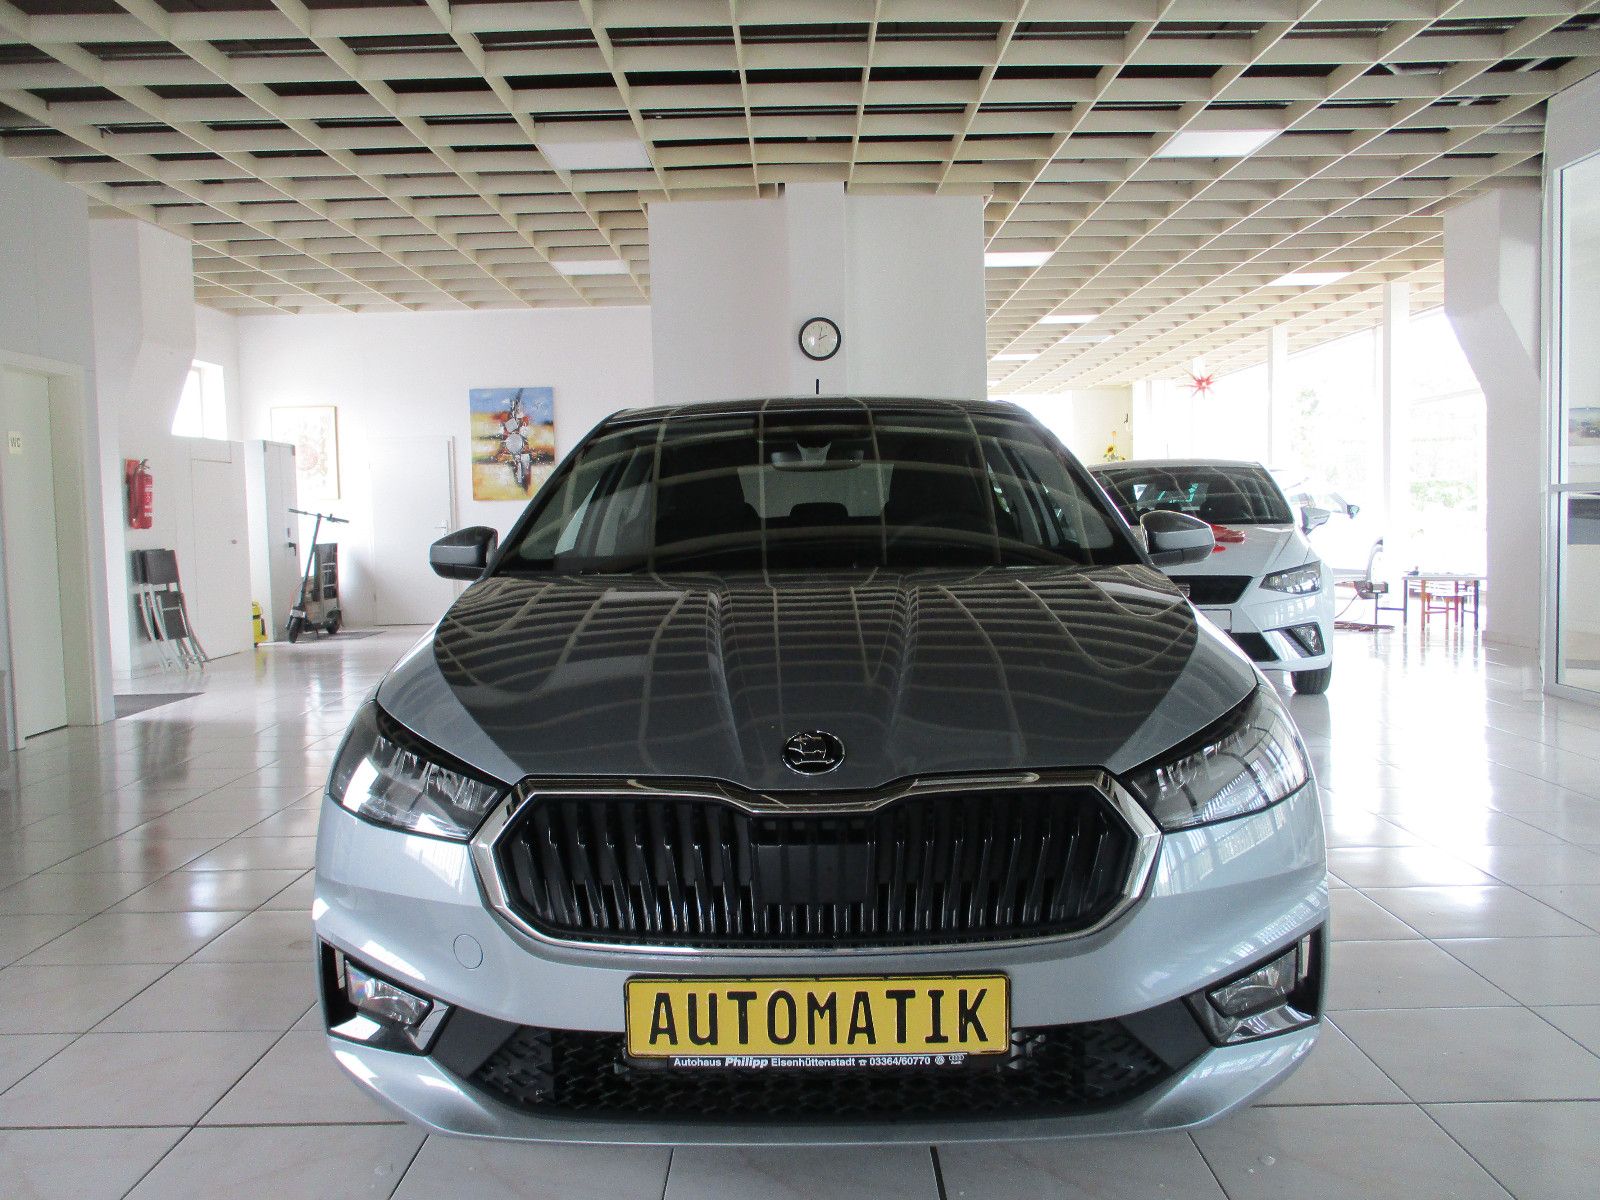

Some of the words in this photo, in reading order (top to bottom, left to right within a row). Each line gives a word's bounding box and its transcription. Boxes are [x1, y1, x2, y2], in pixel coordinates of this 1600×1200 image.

[649, 988, 989, 1046] AUTOMATIK
[674, 1057, 721, 1067] Autohaus
[725, 1057, 768, 1068] Philipp
[771, 1057, 856, 1067] Eisenhüttenstadt
[869, 1056, 931, 1066] 03364/60770
